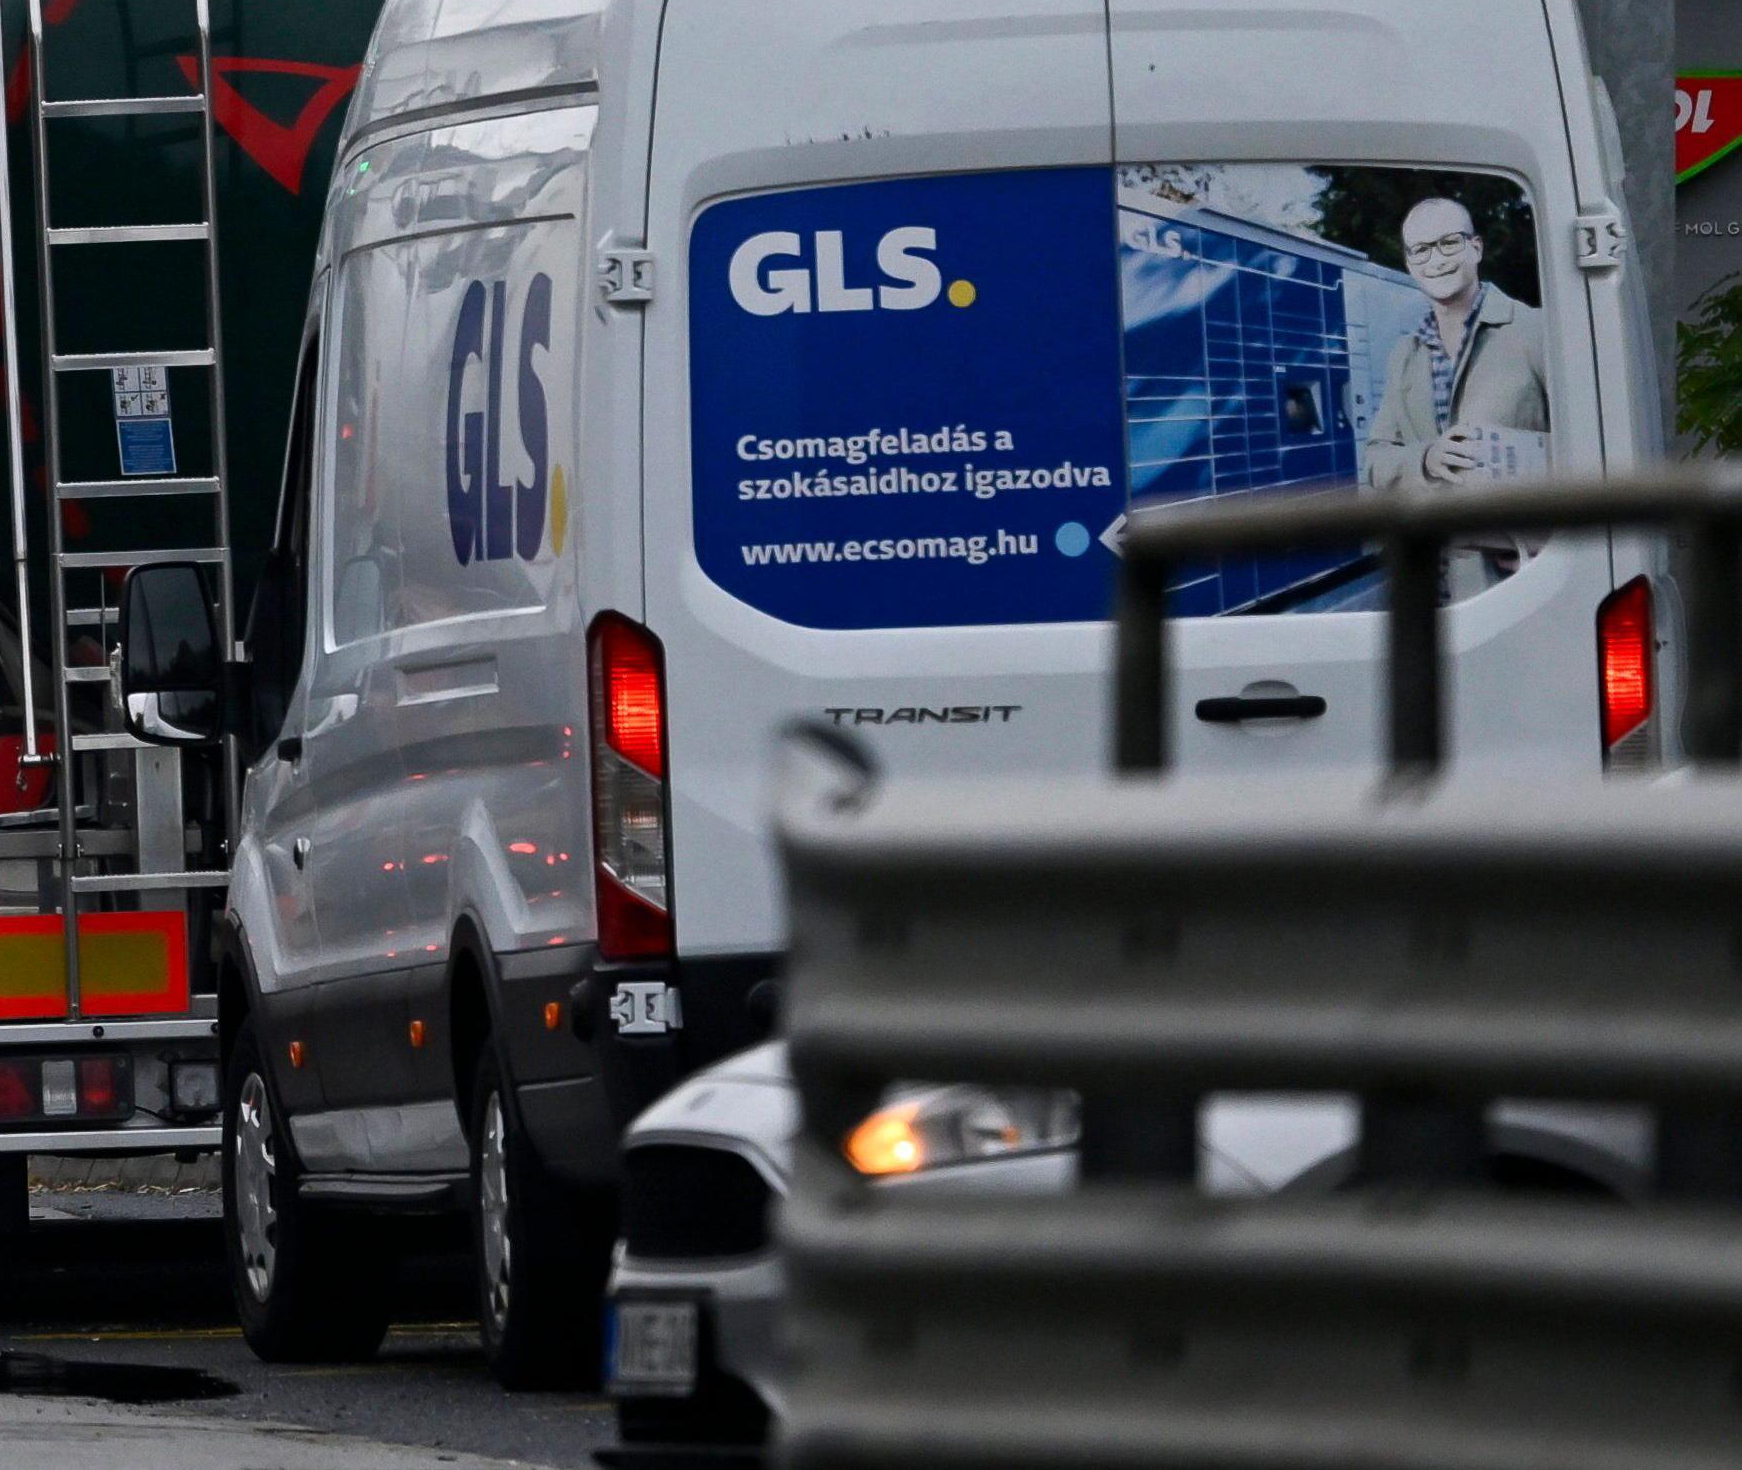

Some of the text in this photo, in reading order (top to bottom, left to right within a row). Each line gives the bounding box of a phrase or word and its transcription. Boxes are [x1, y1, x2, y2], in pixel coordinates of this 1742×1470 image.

[1685, 221, 1723, 235] MOL
[736, 424, 1015, 465] Csomagfeladás a
[737, 461, 1112, 500] szokásaidhoz igazodva
[741, 529, 1039, 566] www.ecsomag.hu
[824, 704, 1023, 725] TRANSIT
